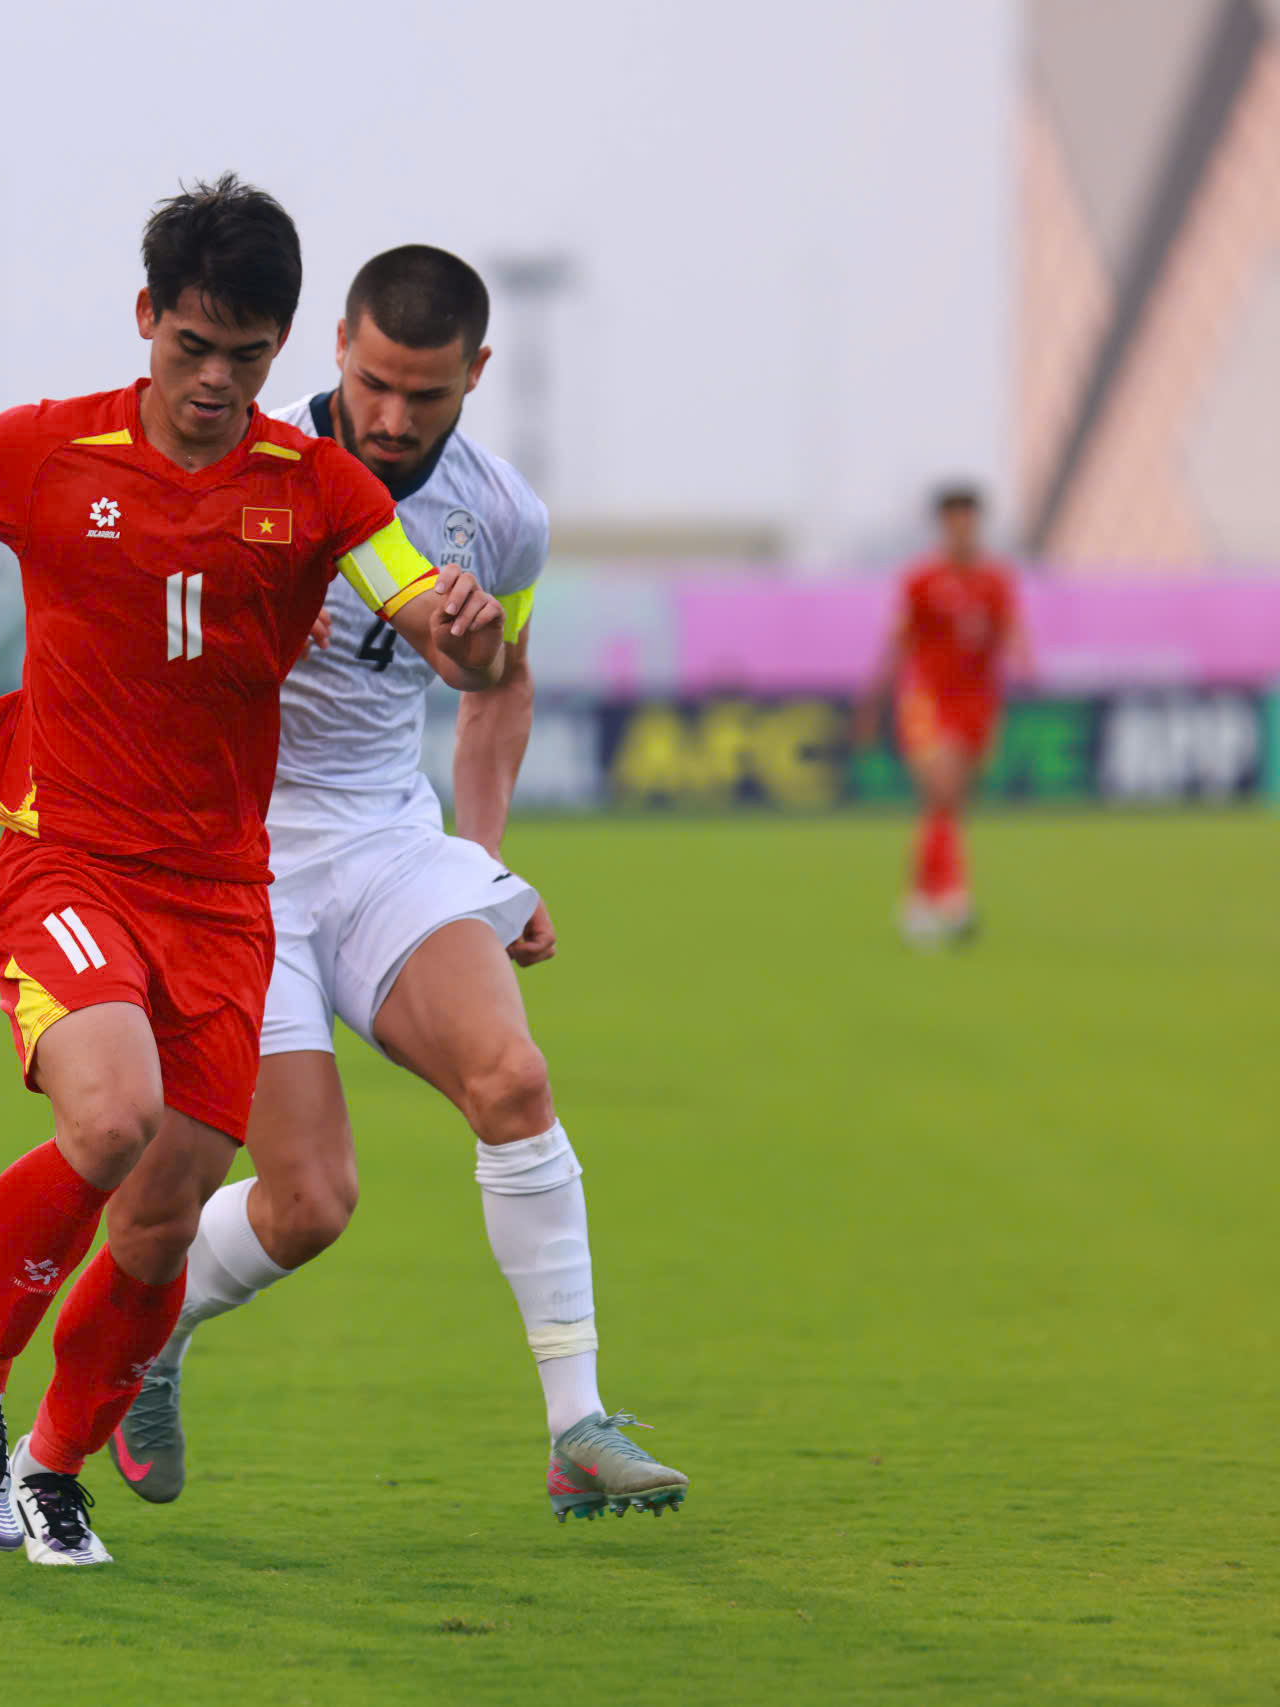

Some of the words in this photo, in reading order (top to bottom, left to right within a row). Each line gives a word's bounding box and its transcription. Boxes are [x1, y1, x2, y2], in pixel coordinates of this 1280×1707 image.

[440, 553, 472, 569] KFU
[166, 571, 203, 661] 11
[355, 616, 397, 672] 4
[613, 700, 838, 806] AFC
[42, 906, 107, 975] 11
